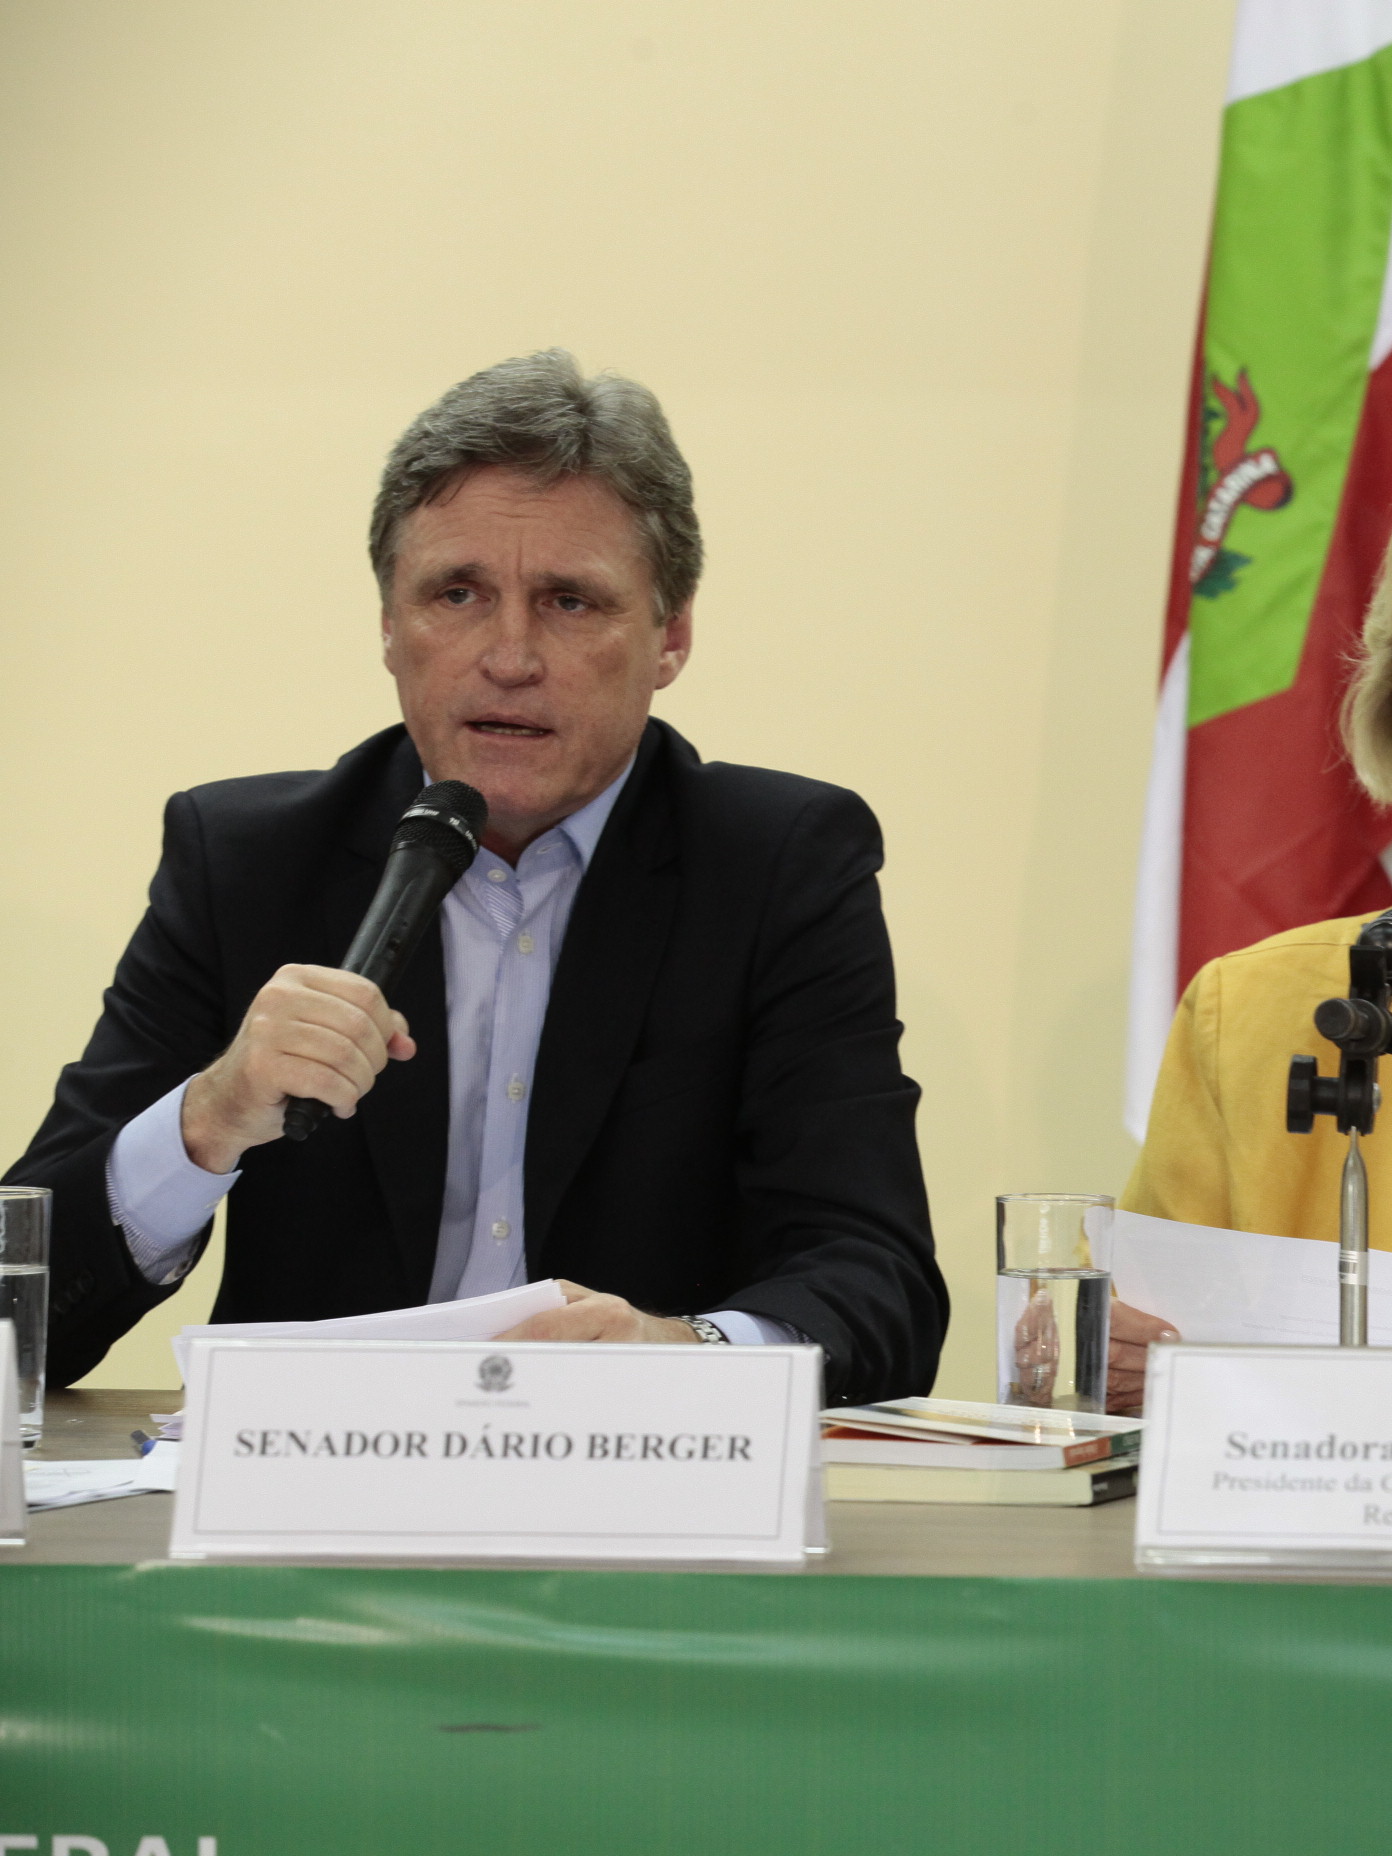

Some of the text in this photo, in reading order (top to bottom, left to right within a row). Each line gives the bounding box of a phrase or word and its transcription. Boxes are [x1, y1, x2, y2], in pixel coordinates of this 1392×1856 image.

[235, 1422, 754, 1462] SENADOR DÁRIO BERGER
[1212, 1471, 1338, 1493] Presidente
[1344, 1473, 1373, 1493] da
